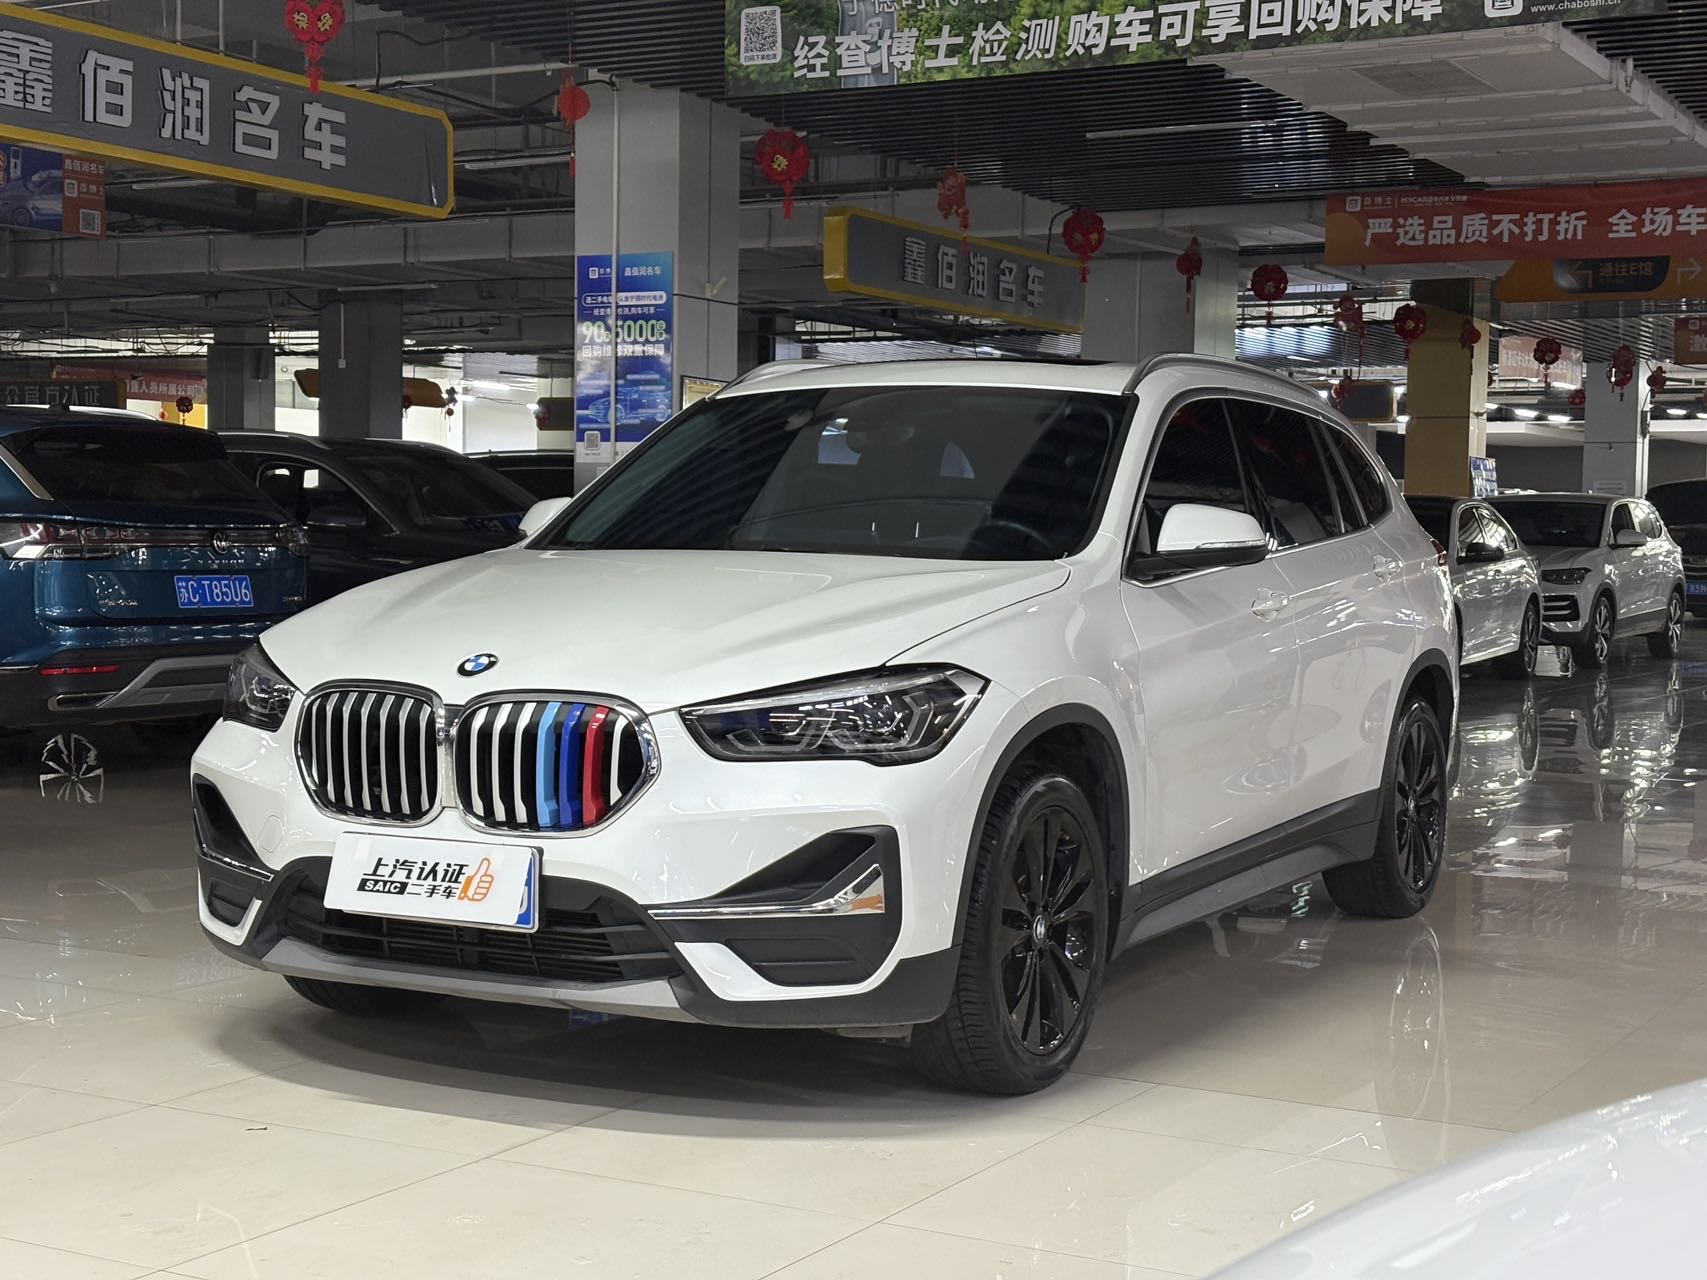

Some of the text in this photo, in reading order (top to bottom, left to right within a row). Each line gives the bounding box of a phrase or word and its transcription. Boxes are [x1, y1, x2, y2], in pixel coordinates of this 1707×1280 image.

[0, 29, 347, 171] 鑫佰润名车
[1364, 204, 1707, 248] 严选品质不打折 全场车
[903, 236, 1046, 308] 鑫佰润名车
[362, 857, 469, 884] 上汽认证
[364, 880, 460, 900] SAIC 二手车
